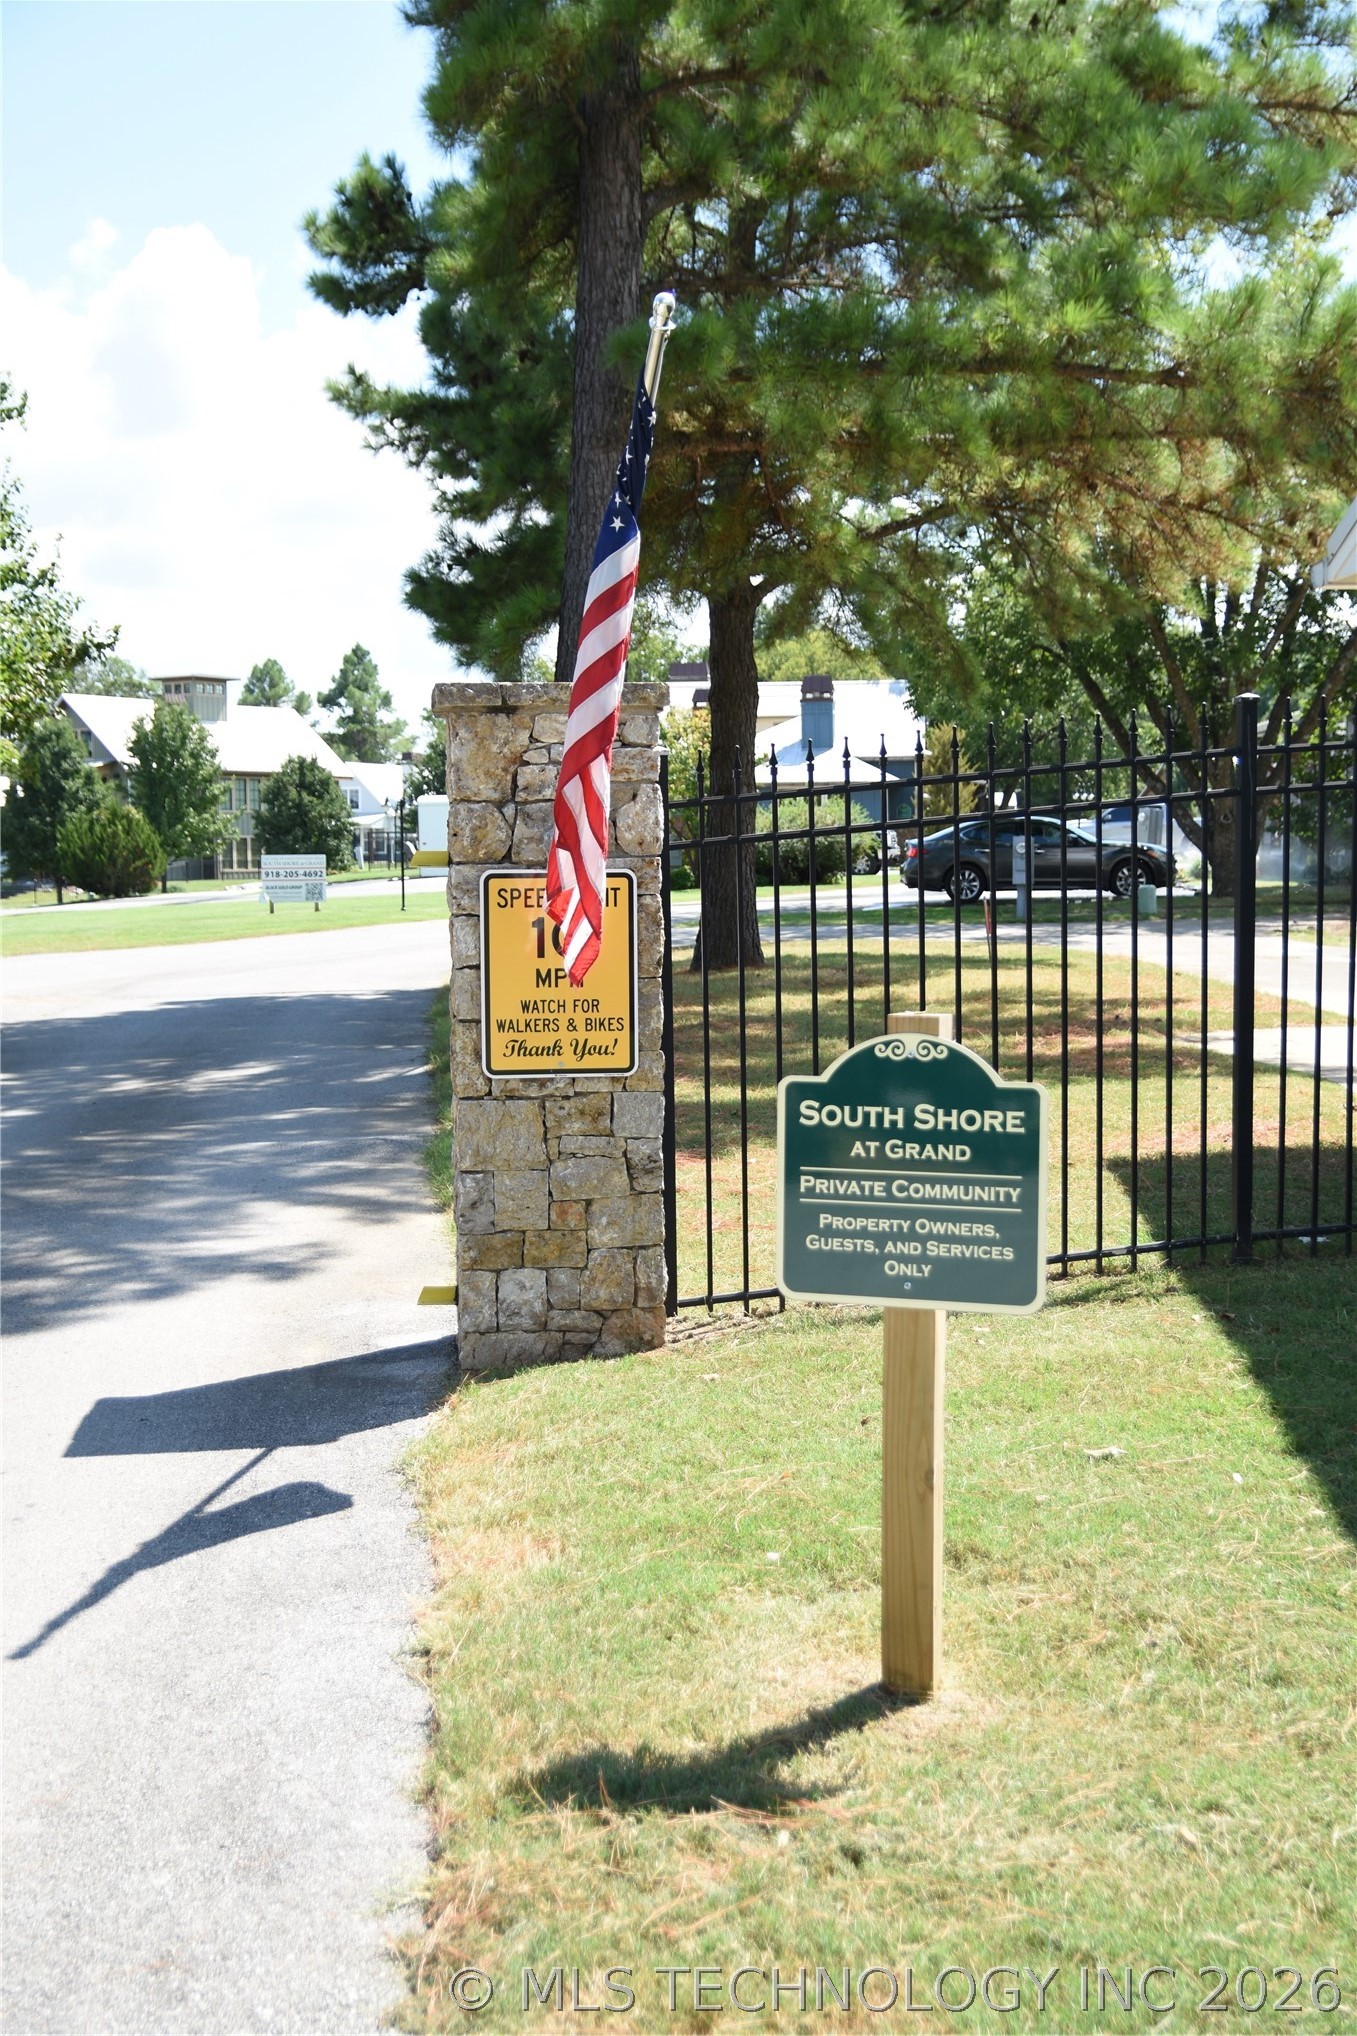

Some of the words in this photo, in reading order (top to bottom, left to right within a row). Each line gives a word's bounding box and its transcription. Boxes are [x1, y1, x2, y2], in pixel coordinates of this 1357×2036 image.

[264, 870, 323, 878] 918-205-4692
[497, 888, 546, 908] SPEE
[535, 967, 584, 988] MP
[520, 999, 566, 1014] WATCH
[573, 999, 600, 1013] FOR
[496, 1018, 560, 1033] WALKERS
[566, 1018, 578, 1032] &
[585, 1017, 625, 1032] BIKES
[503, 1038, 564, 1058] Thank
[569, 1037, 618, 1062] You!
[799, 1099, 904, 1129] SOUTH
[913, 1103, 1026, 1134] SHORE
[850, 1141, 880, 1157] AT
[885, 1139, 971, 1161] GRAND
[799, 1175, 887, 1196] PRIVATE
[891, 1179, 1022, 1203] COMMUNITY
[819, 1213, 911, 1233] PROPERTY
[915, 1218, 1001, 1240] OWNERS,
[805, 1234, 880, 1256] GUESTS,
[884, 1241, 922, 1255] AND
[926, 1240, 1015, 1260] SERVICES
[884, 1260, 933, 1277] ONLY
